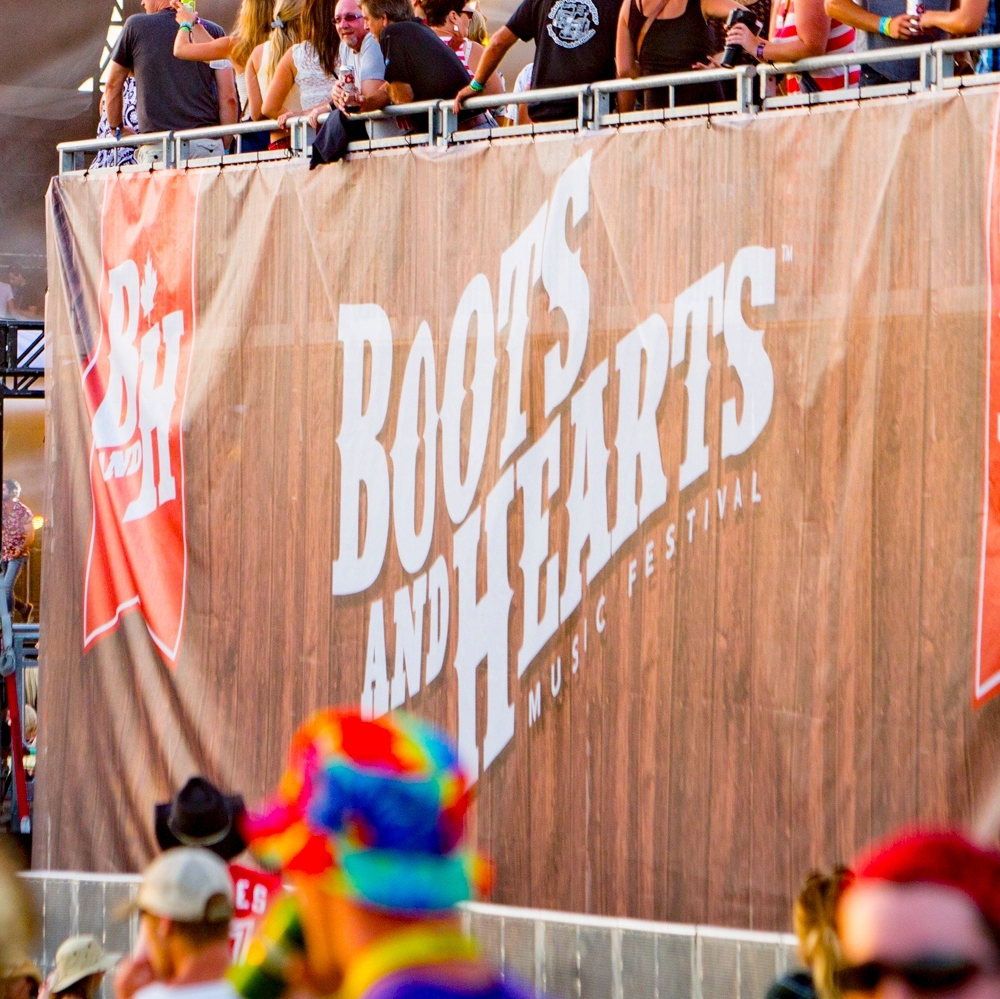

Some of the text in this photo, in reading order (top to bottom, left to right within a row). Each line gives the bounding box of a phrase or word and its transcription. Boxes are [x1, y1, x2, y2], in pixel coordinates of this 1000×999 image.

[332, 149, 593, 596] BOOTS
[452, 245, 776, 787] HEARTS
[360, 555, 451, 724] AND
[528, 471, 762, 729] MUSIC FESTIVAL
